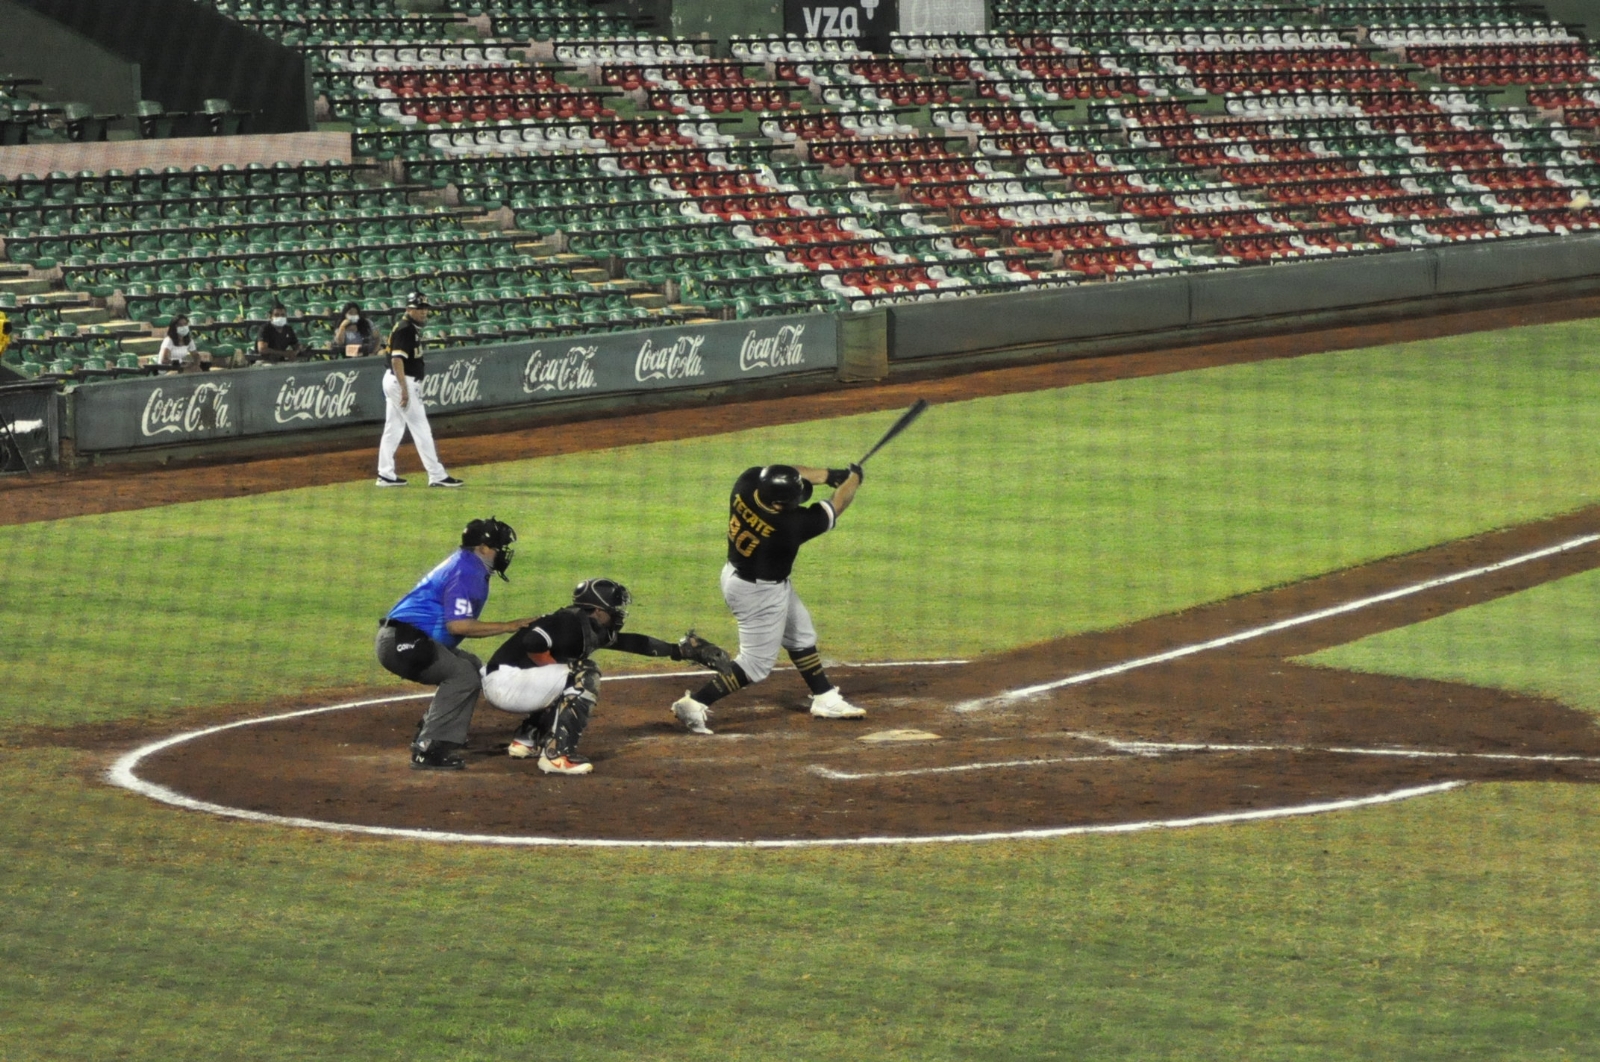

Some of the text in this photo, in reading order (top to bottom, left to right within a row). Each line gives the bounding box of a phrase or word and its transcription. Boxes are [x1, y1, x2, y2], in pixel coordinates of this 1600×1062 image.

[421, 357, 483, 406] ca-Cola
[141, 382, 232, 437] Coca-Cla
[733, 493, 776, 538] TECATE
